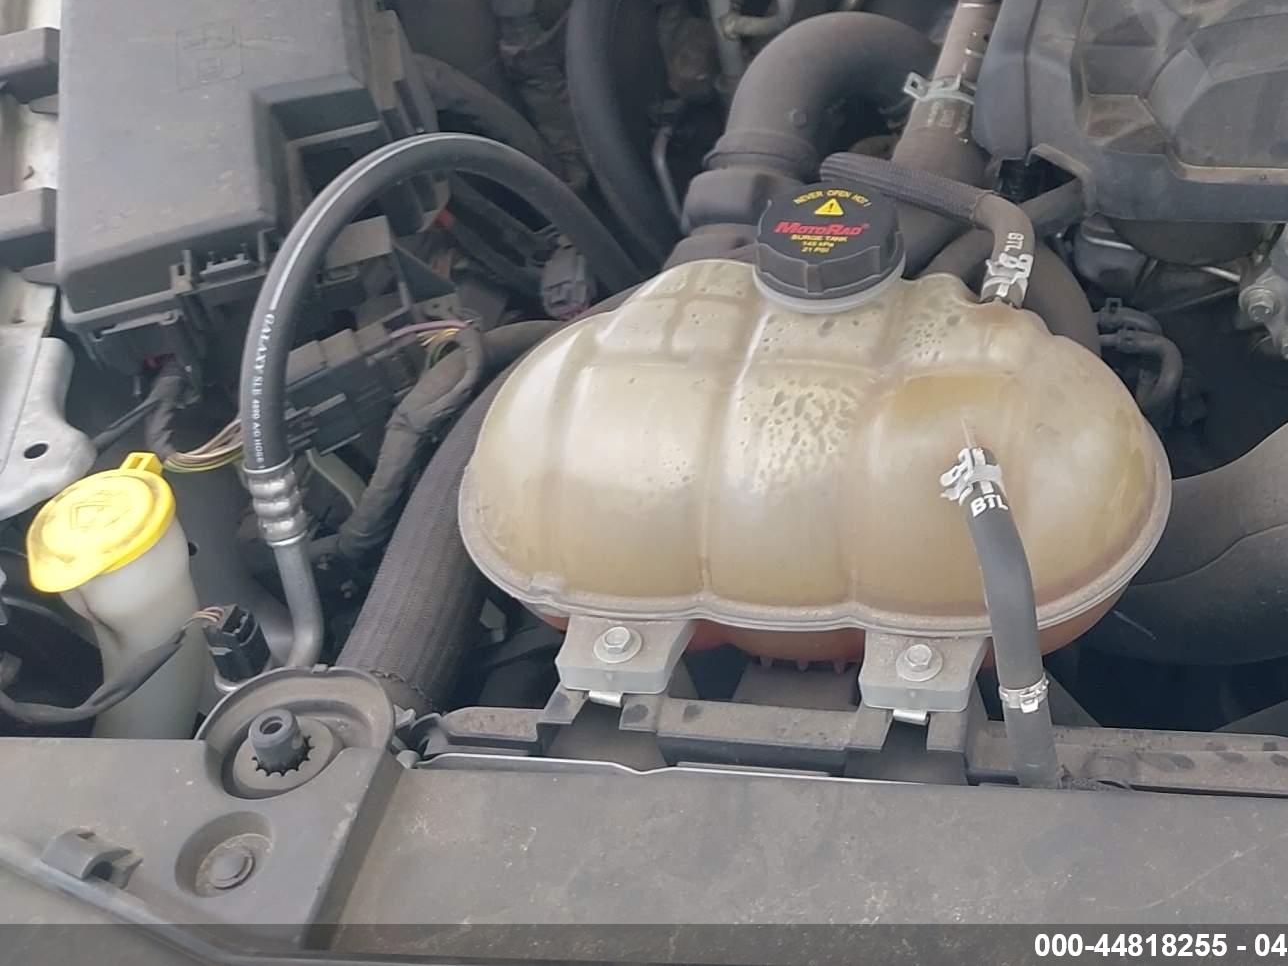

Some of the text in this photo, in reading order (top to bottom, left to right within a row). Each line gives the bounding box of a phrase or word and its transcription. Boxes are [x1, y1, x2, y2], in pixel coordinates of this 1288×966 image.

[793, 190, 823, 204] NEVER
[826, 189, 852, 199] OPEN
[1004, 232, 1025, 252] BTL
[254, 313, 275, 374] GALAXY
[970, 494, 1009, 518] BTL
